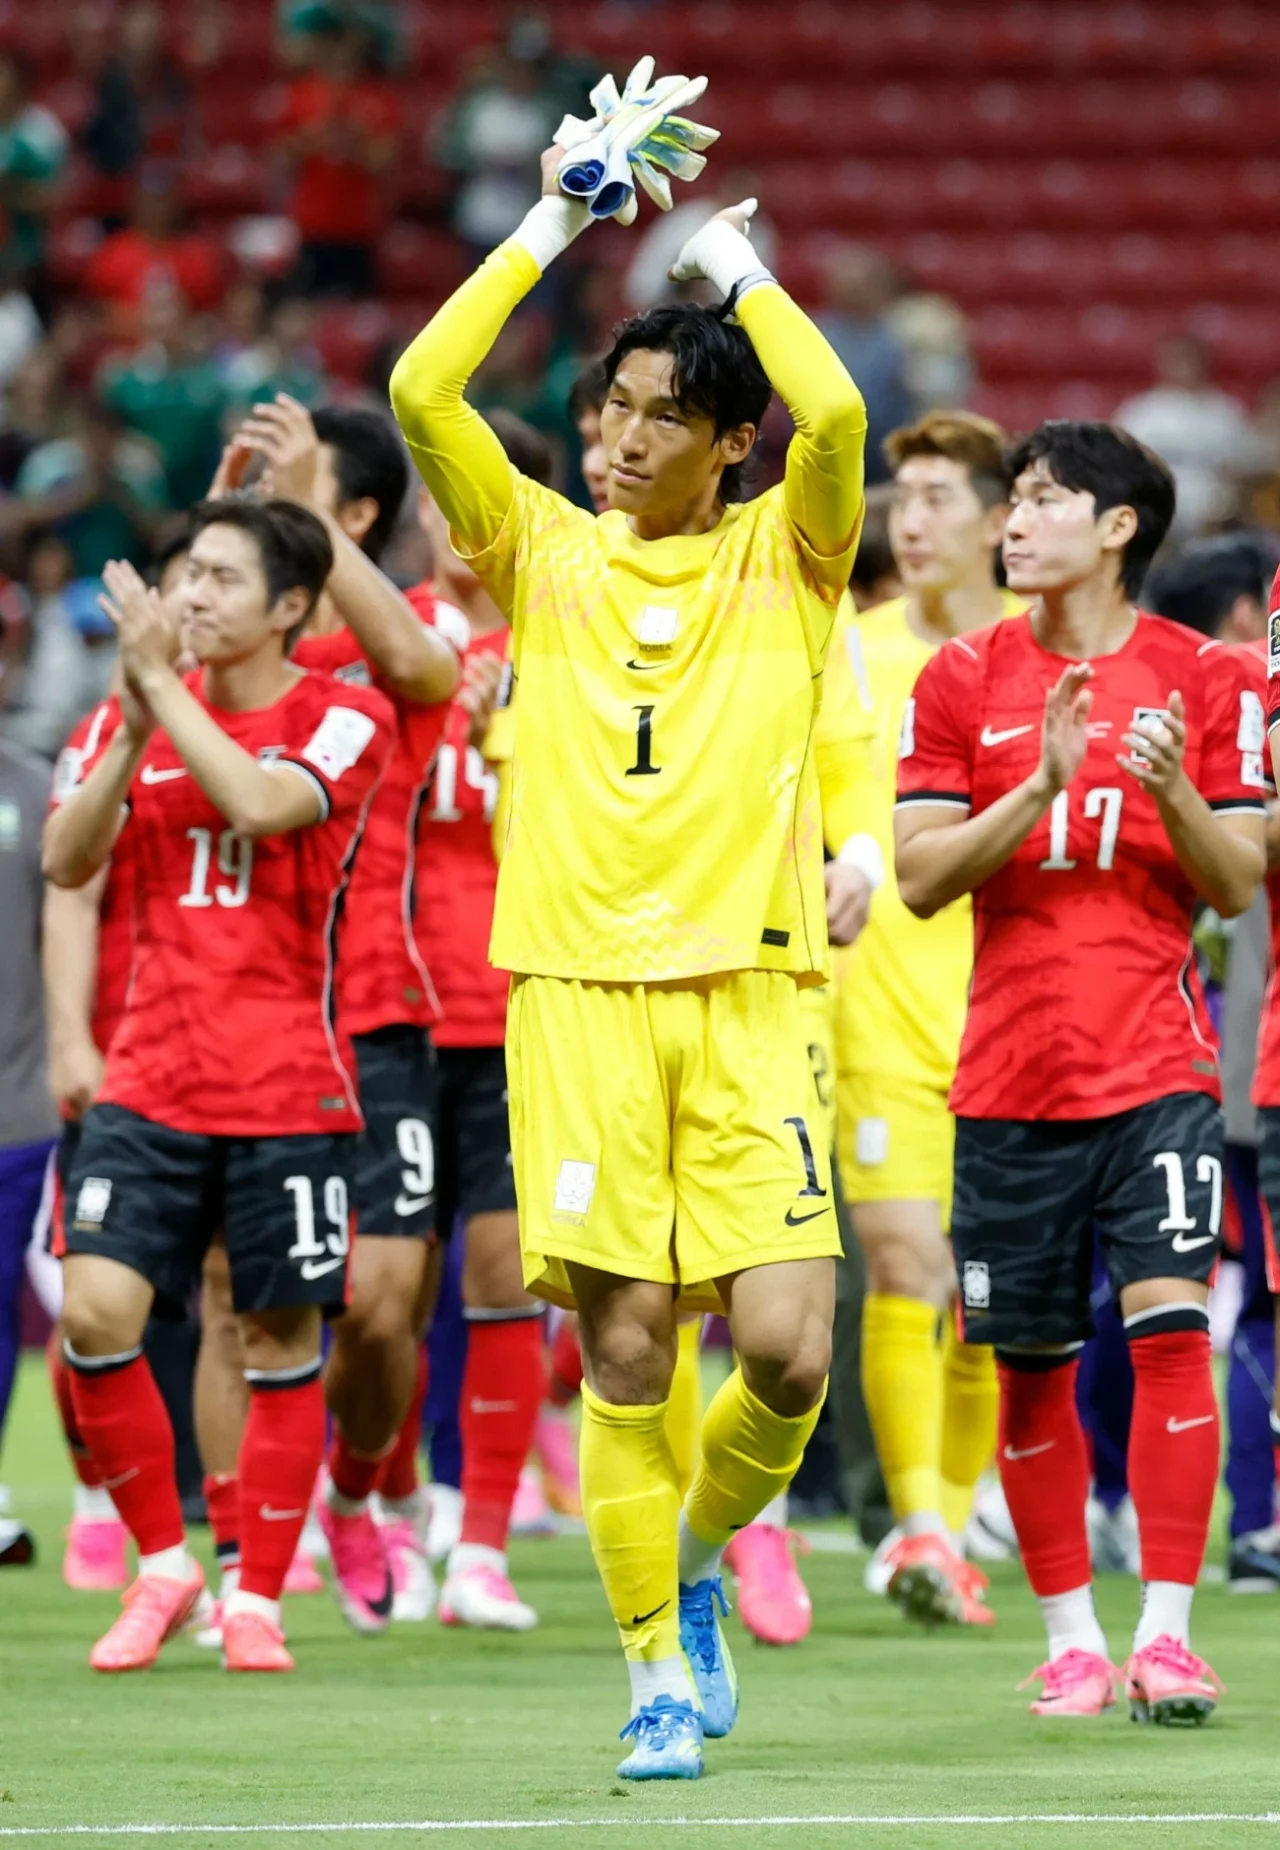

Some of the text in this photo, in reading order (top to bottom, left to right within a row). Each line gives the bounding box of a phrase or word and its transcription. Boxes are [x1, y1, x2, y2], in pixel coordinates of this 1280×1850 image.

[624, 704, 662, 777] 1
[179, 828, 253, 908] 19
[1040, 787, 1124, 870] 17
[396, 1118, 434, 1194] 9
[783, 1116, 828, 1198] 1
[1152, 1151, 1223, 1237] 17
[283, 1175, 349, 1259] 19
